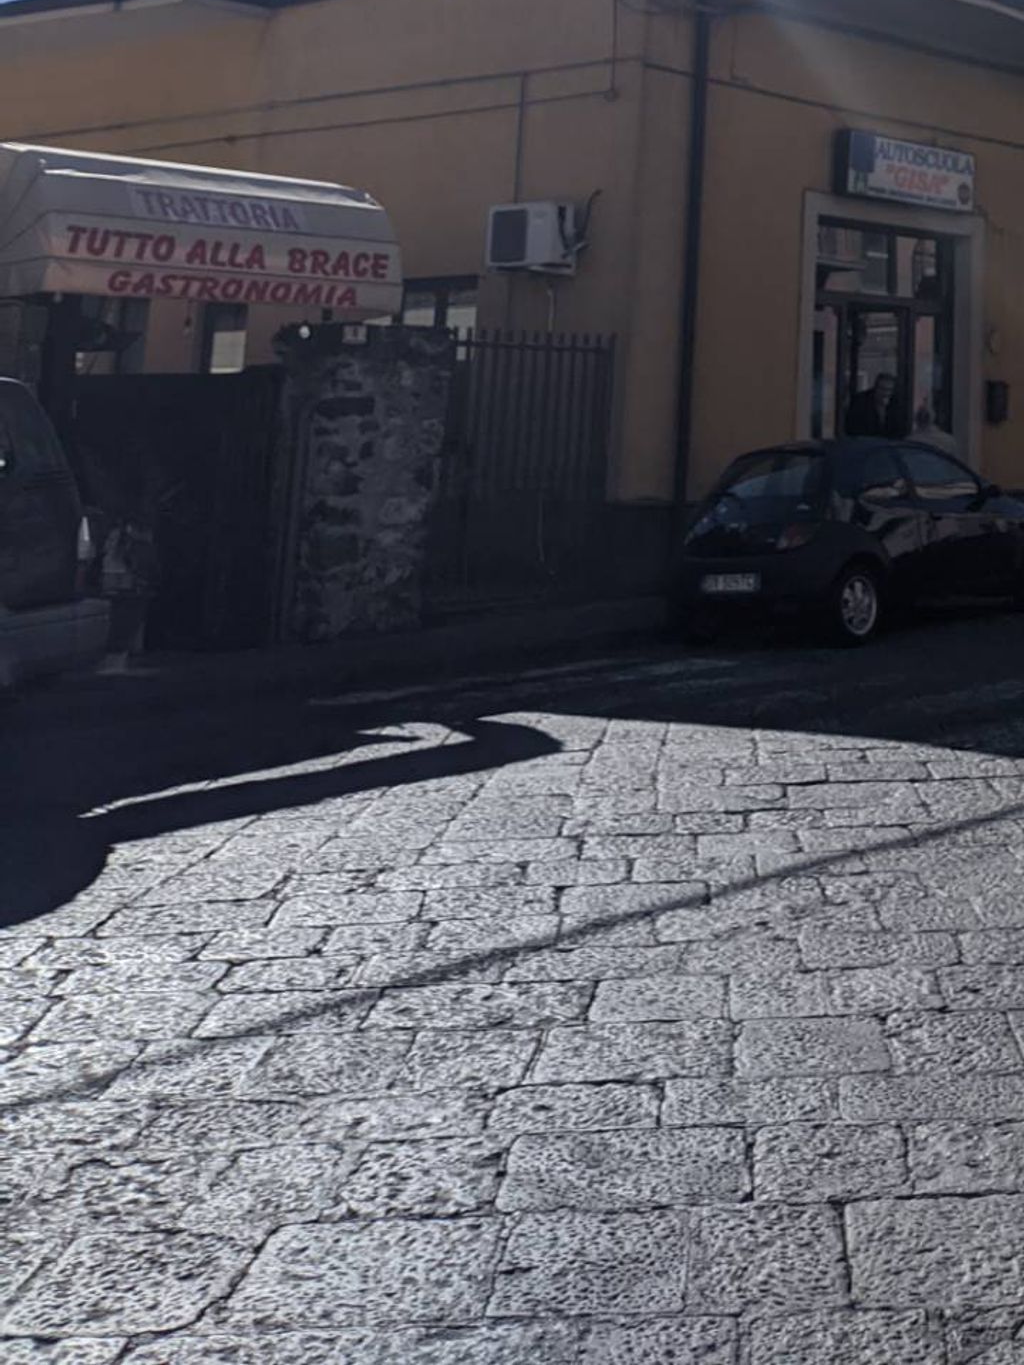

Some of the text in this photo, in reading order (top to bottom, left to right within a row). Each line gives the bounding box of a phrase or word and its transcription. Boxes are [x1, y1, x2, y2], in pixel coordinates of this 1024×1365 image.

[138, 189, 299, 230] TRATTORIA
[66, 225, 390, 279] TUTTO ALLA BRACE
[107, 271, 359, 307] GASTRONOMIA
